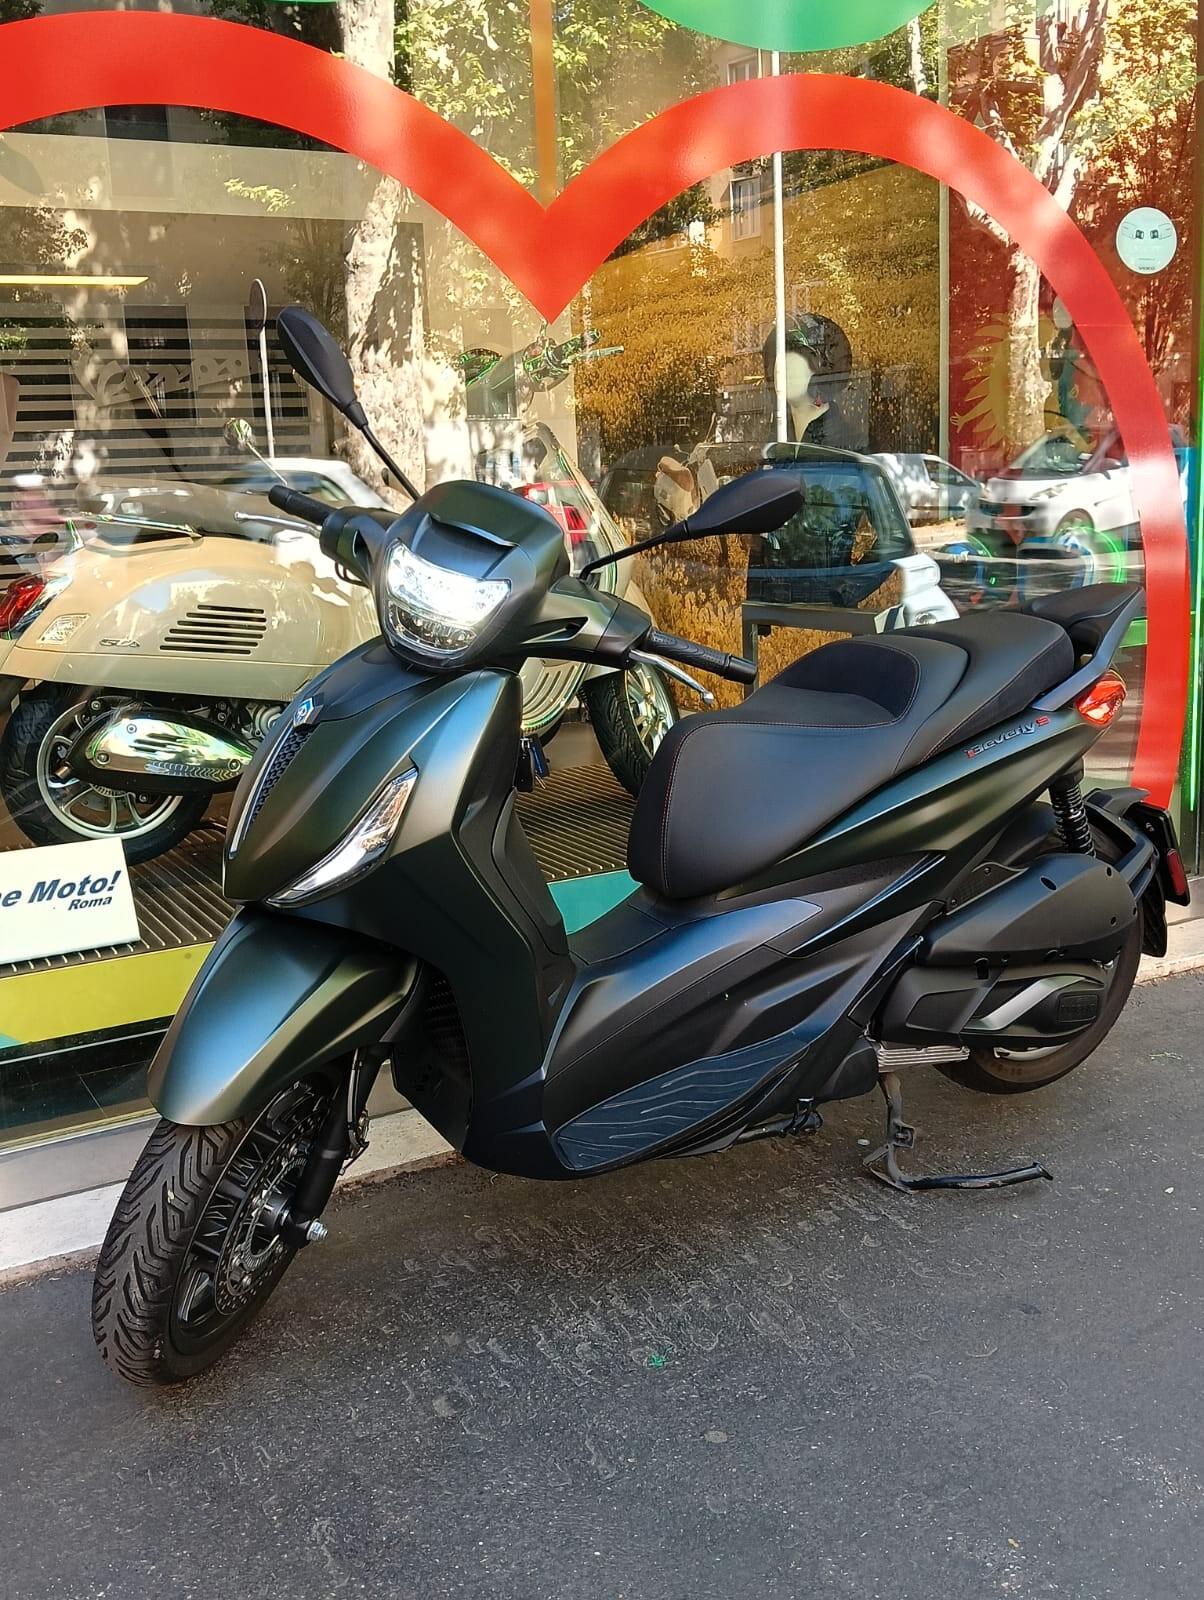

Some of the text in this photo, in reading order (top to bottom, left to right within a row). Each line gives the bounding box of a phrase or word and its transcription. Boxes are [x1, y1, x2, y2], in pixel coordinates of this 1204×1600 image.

[965, 716, 1050, 758] Beverly S
[0, 870, 122, 907] e Moto!
[67, 896, 113, 911] Roma
